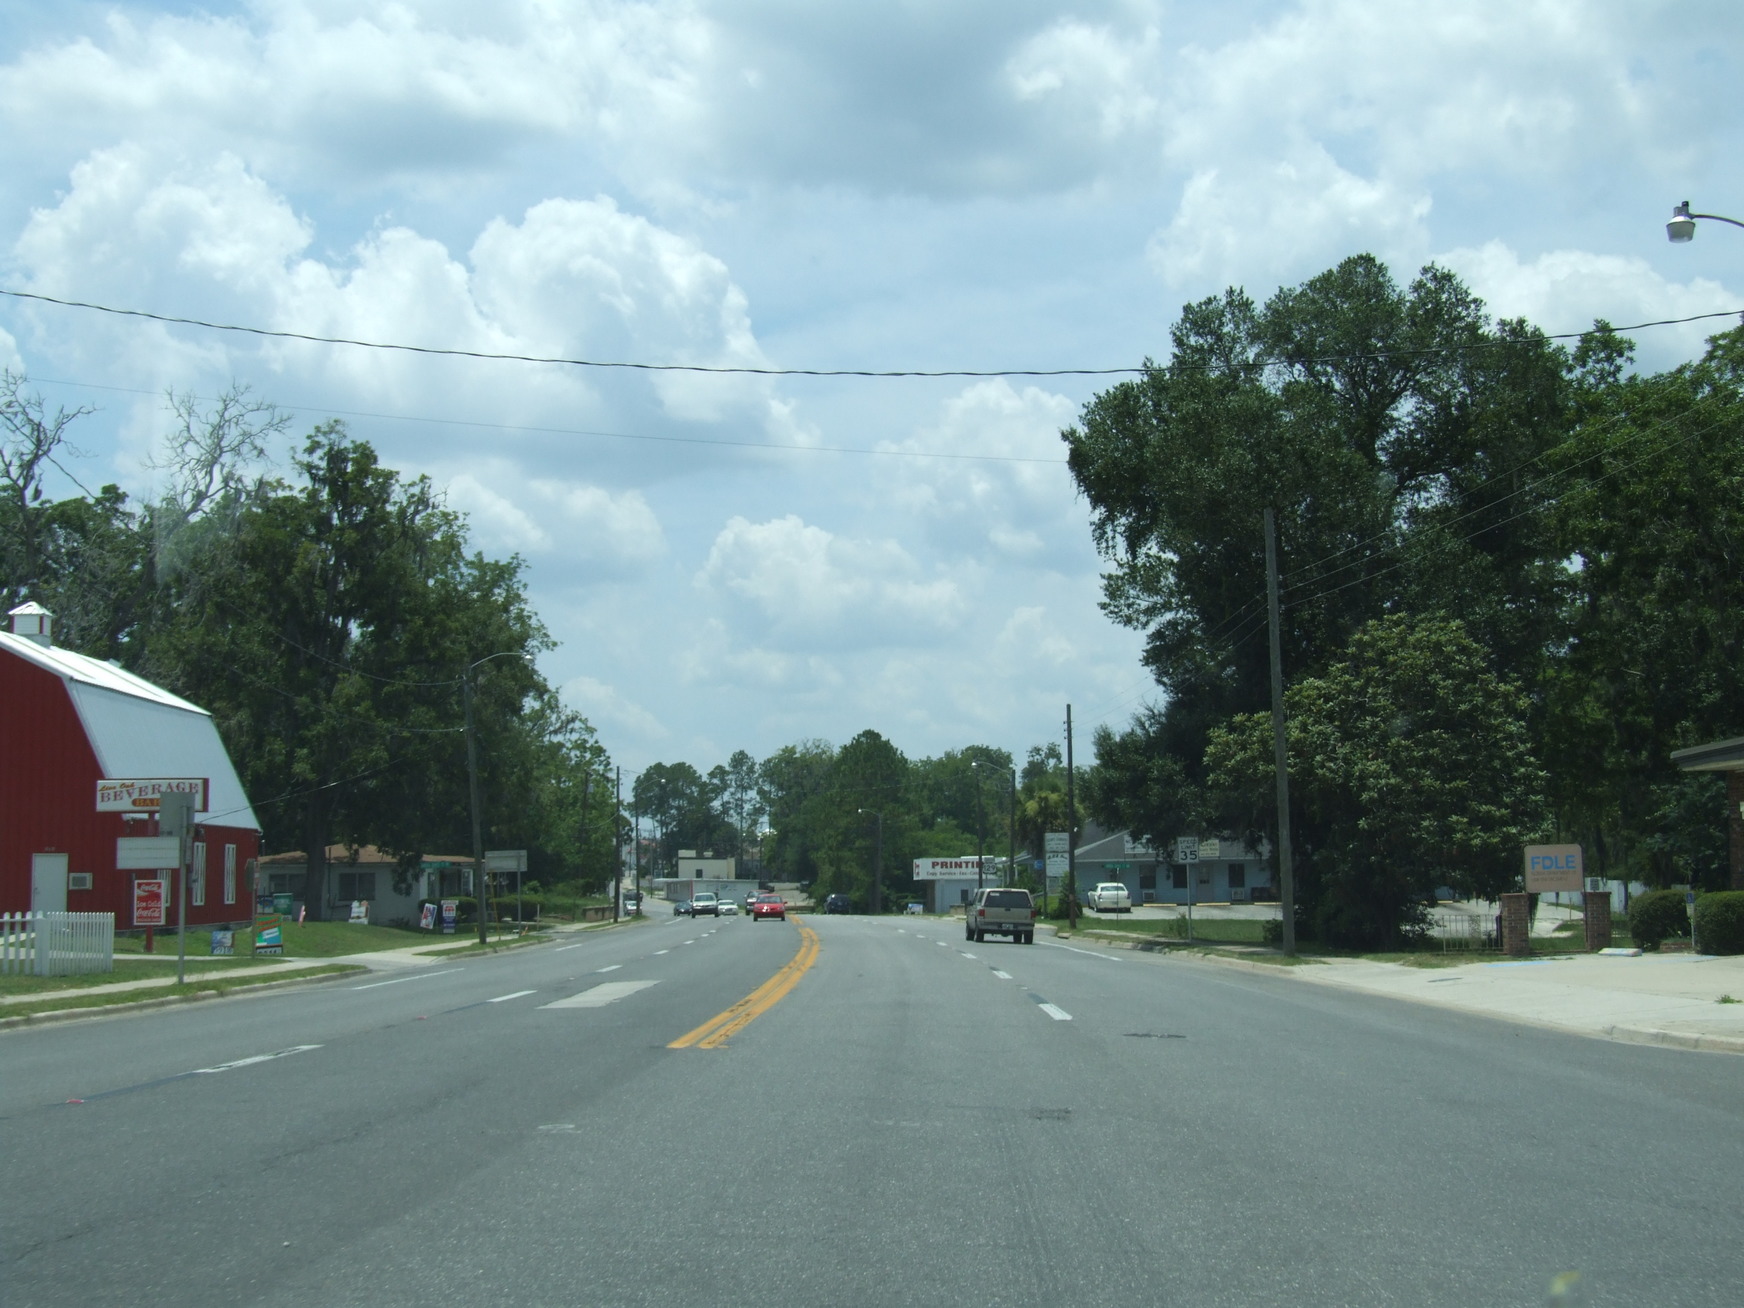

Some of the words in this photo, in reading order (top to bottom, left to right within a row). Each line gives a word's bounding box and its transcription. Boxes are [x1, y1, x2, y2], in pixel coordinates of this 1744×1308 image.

[100, 782, 199, 802] BEVERAGE
[135, 798, 161, 807] BAR
[1180, 850, 1197, 860] 35
[1531, 855, 1576, 870] FDLE
[983, 864, 996, 872] 129
